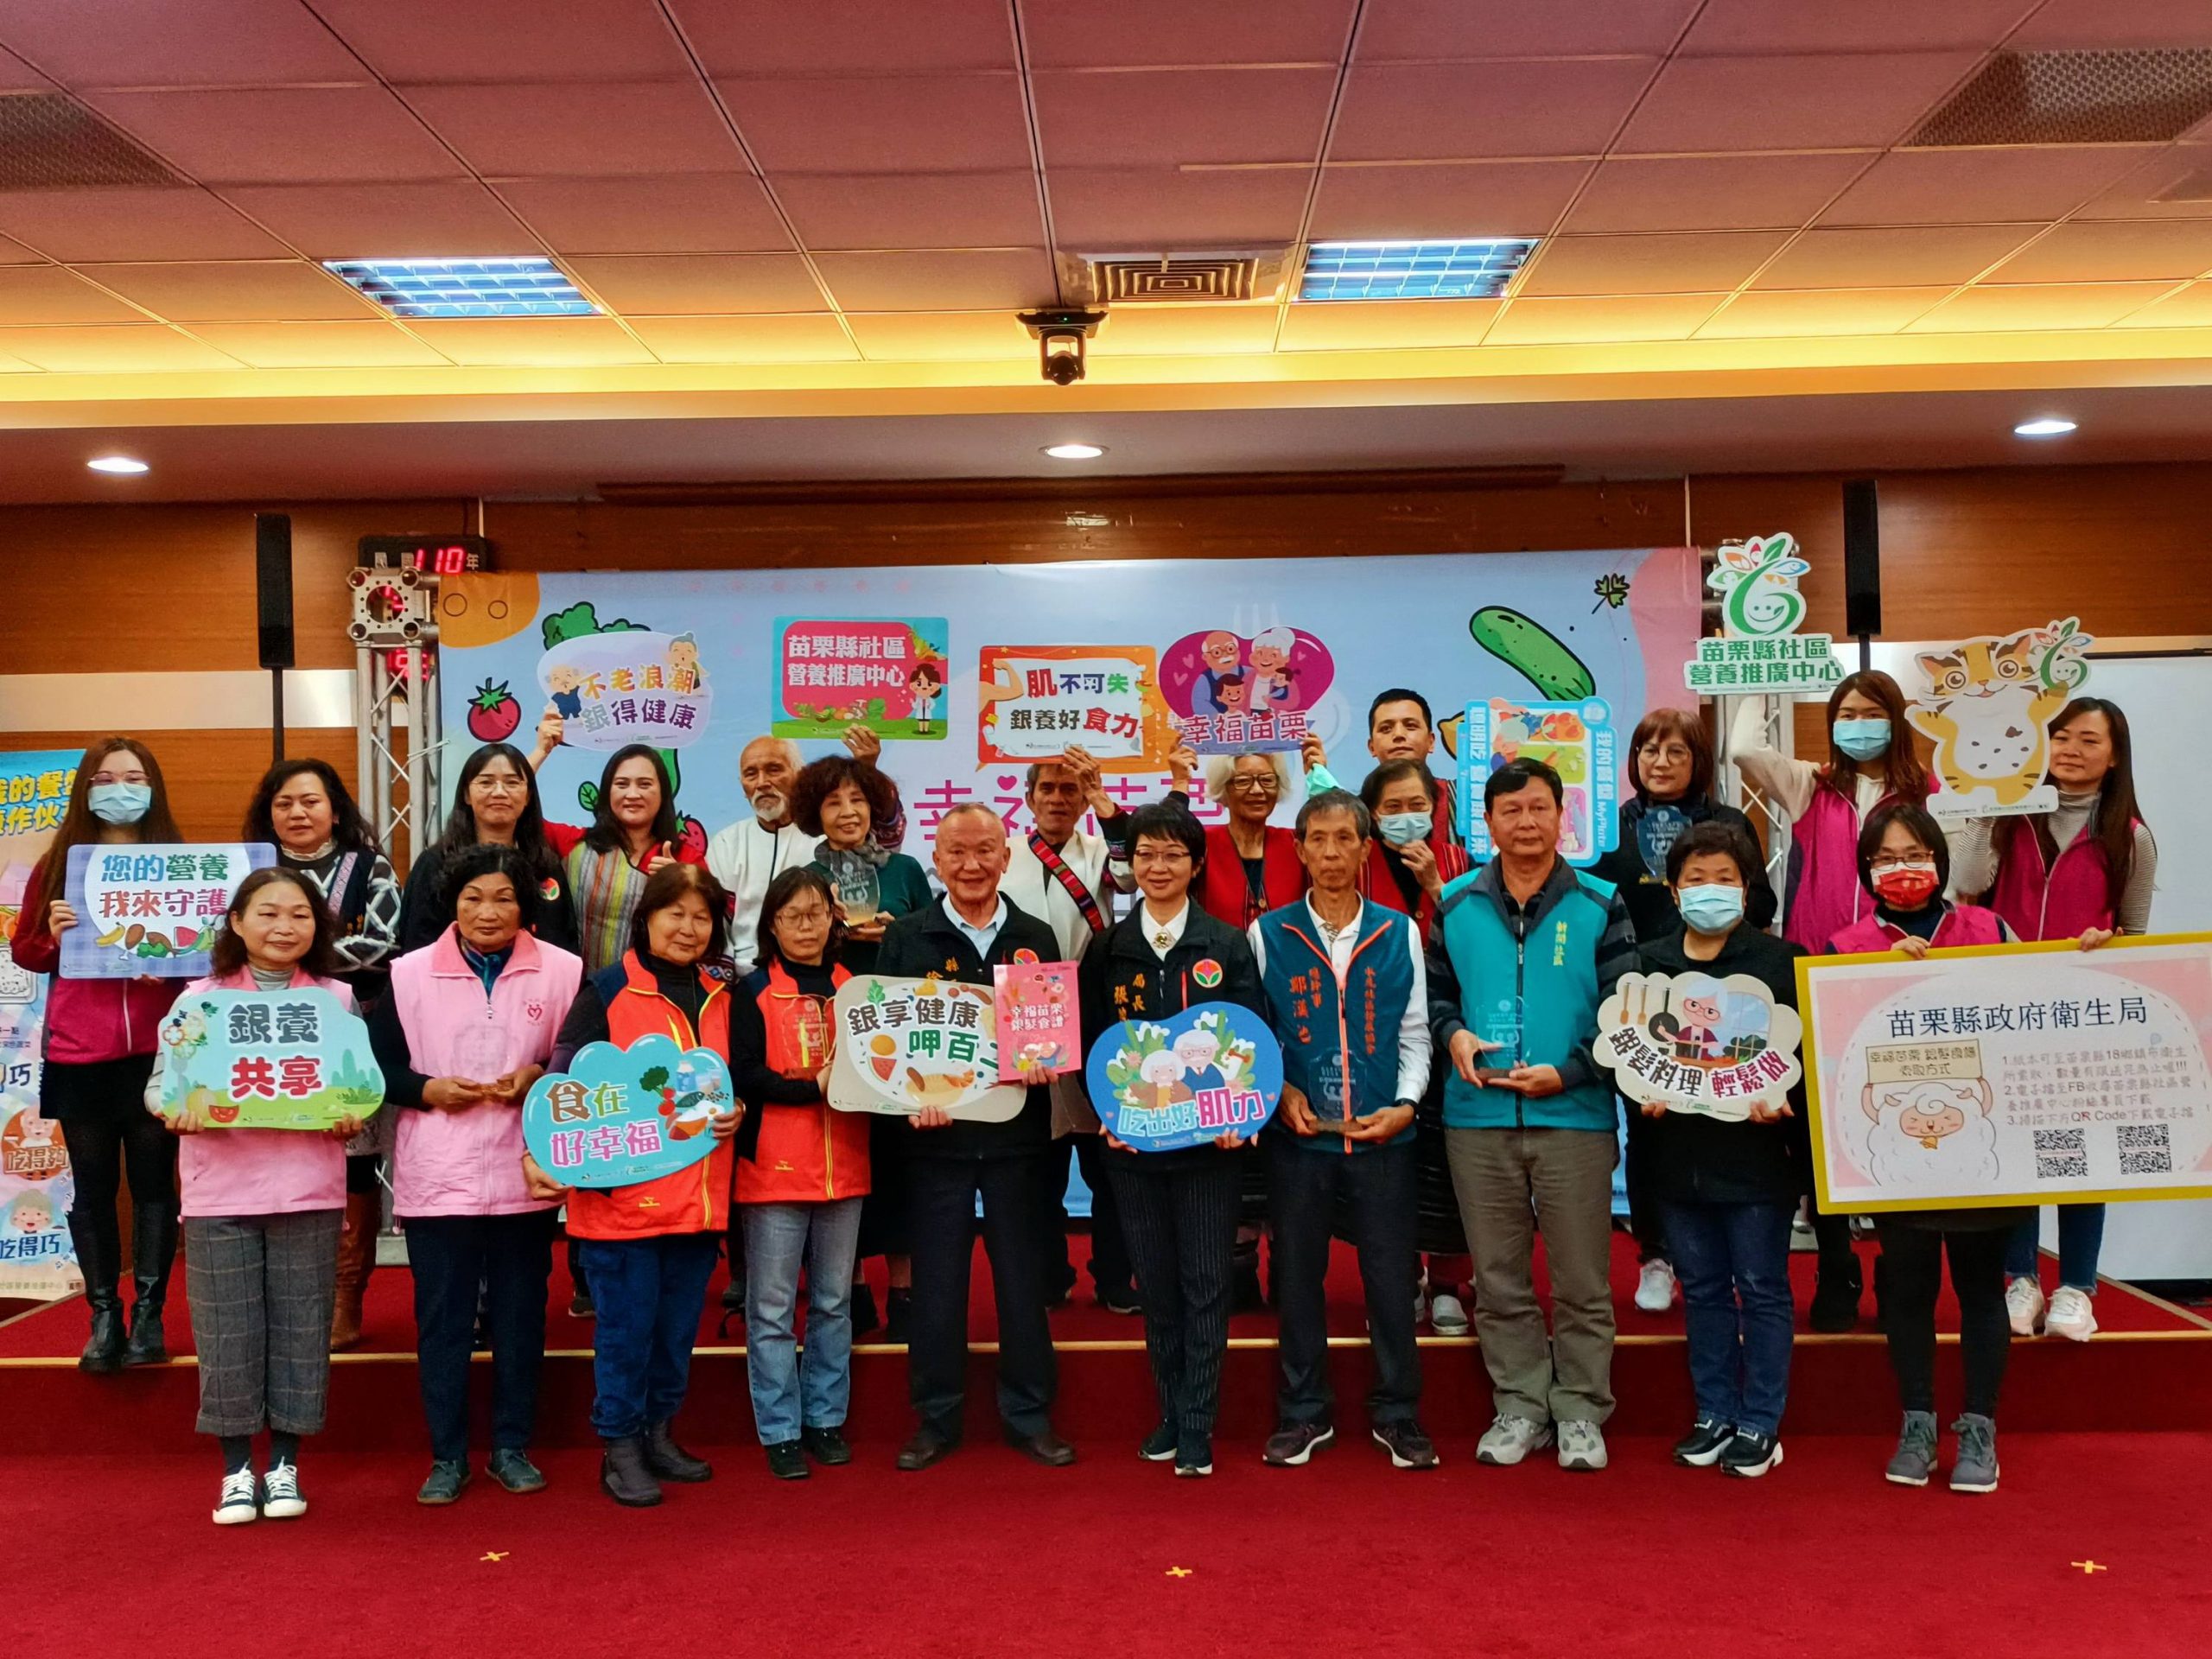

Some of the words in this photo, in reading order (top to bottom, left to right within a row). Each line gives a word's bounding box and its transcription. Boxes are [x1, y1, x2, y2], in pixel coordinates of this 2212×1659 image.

[787, 635, 906, 659] 苗栗縣社區
[1701, 638, 1827, 663] 苗栗縣社區
[579, 664, 695, 700] 不老浪潮
[787, 663, 906, 688] 營養推廣中心
[1026, 668, 1129, 698] 肌不可失
[1689, 660, 1842, 685] 營養推廣中心
[580, 698, 697, 733] 銀得健康
[1010, 707, 1139, 739] 銀養好食力
[1184, 711, 1308, 744] 幸福苗栗
[0, 800, 69, 835] 作伙
[101, 854, 229, 882] 您的營養
[99, 889, 229, 918] 我來守護
[228, 1002, 320, 1045] 銀養
[846, 998, 981, 1036] 銀享健康
[1886, 996, 2147, 1039] 苗栗縣政府衛生局
[231, 1056, 322, 1099] 共享
[1607, 1026, 1703, 1097] 銀髮料理
[1711, 1050, 1790, 1098] 輕鬆做
[546, 1080, 630, 1123] 食在
[1117, 1087, 1266, 1137] 吃出好肌力
[550, 1120, 663, 1166] 好幸福
[0, 1233, 61, 1260] 吃得巧
